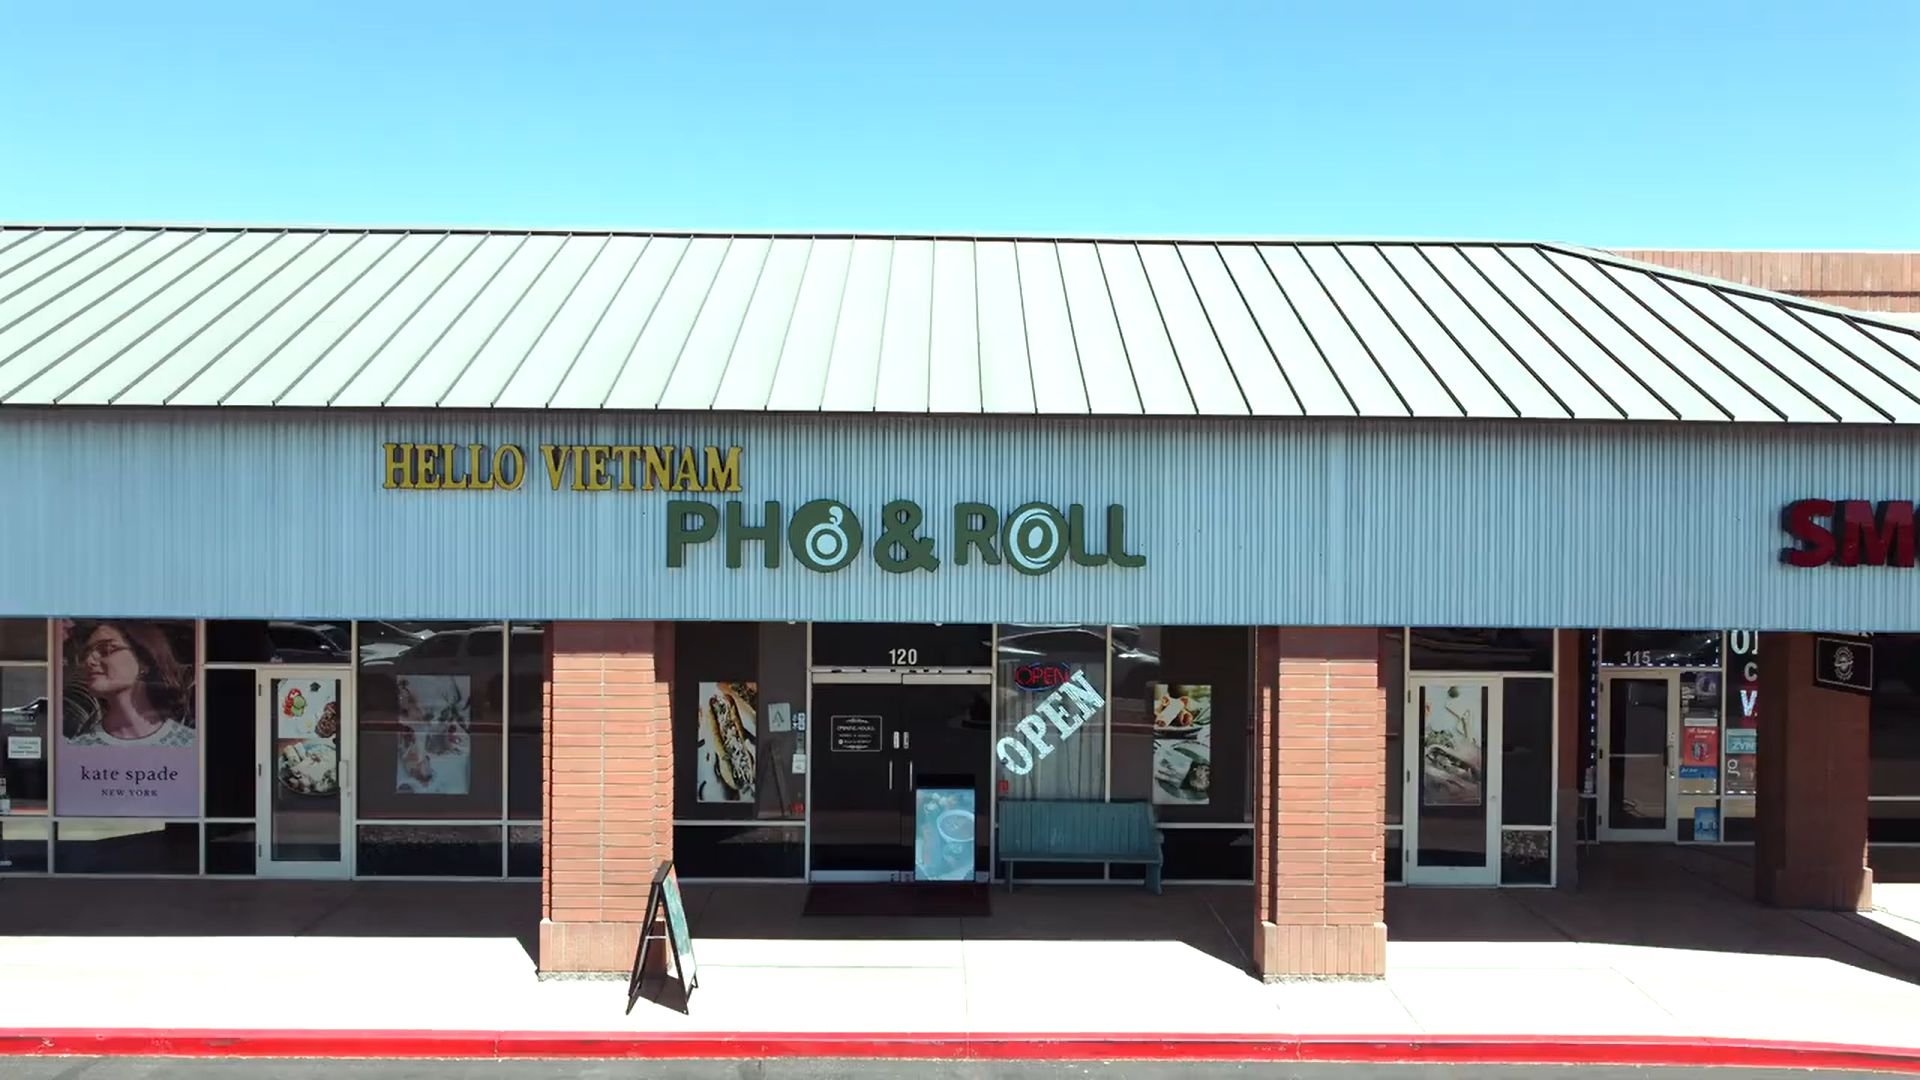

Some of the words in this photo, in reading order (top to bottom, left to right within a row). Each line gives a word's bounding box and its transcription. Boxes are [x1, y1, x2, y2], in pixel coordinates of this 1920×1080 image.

[383, 443, 525, 491] HELLO
[540, 444, 743, 492] VIETNAM
[873, 498, 941, 573] &
[953, 501, 1147, 576] ROLL
[1778, 498, 1920, 568] SM
[889, 648, 917, 665] 120
[1624, 650, 1651, 665] 115
[1015, 665, 1071, 686] OPEN
[996, 669, 1105, 775] OPEN
[81, 765, 119, 781] kate
[125, 765, 178, 785] spade
[101, 788, 124, 796] NEW
[128, 788, 158, 797] YORK
